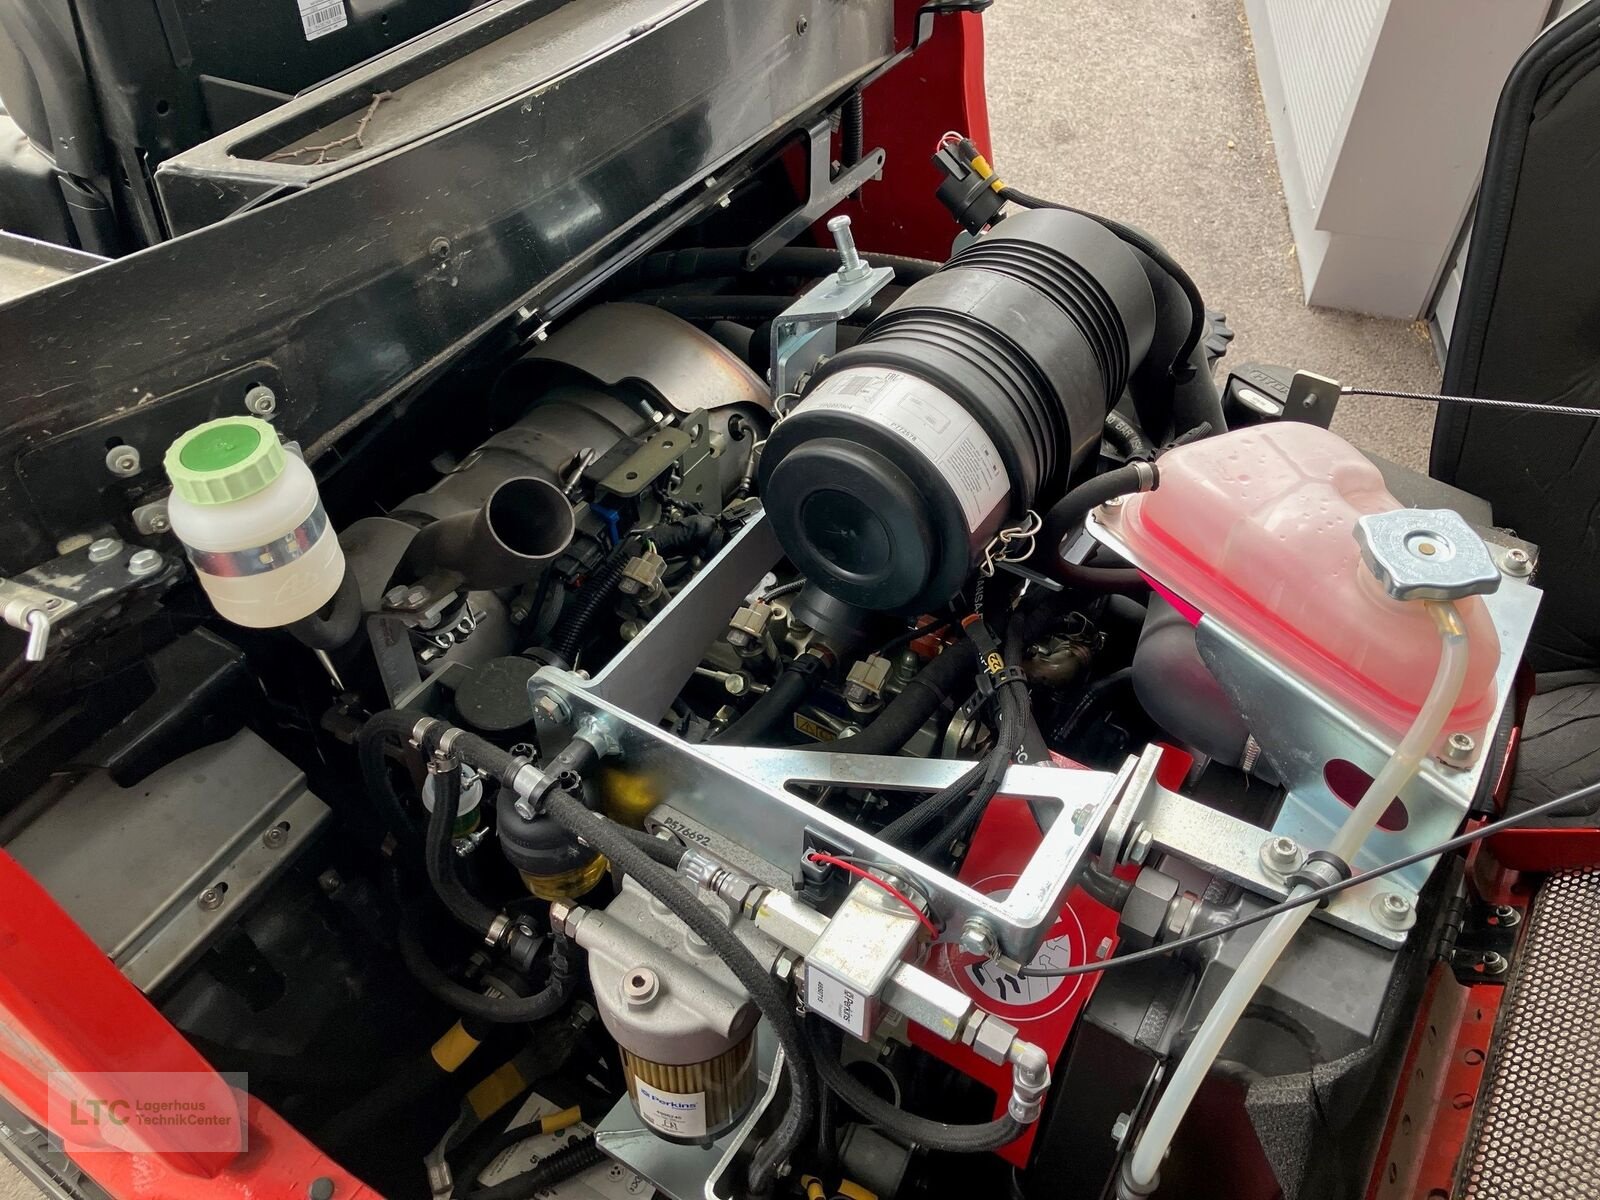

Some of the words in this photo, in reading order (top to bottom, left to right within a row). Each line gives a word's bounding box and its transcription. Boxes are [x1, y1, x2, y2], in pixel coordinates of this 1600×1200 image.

[990, 654, 1002, 670] 22
[664, 817, 711, 847] P576692
[651, 1095, 697, 1109] Perkins
